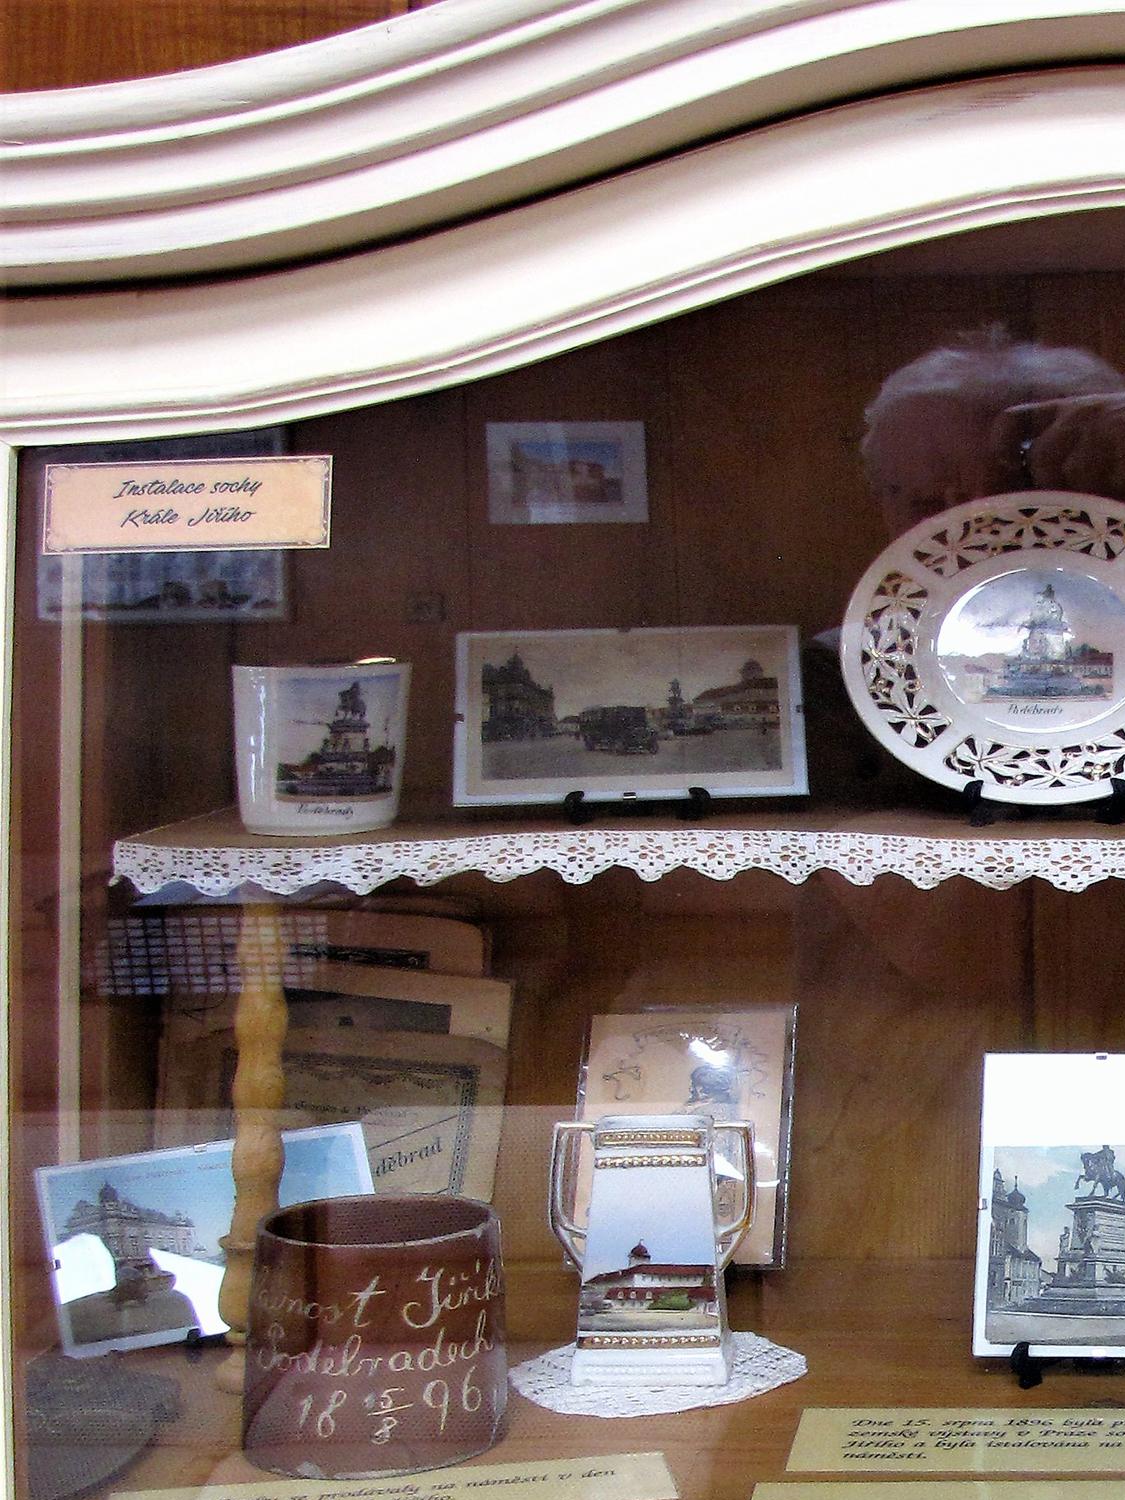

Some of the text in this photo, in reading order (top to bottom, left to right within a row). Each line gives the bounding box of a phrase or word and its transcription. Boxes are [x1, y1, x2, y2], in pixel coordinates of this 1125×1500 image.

[112, 477, 263, 499] Instalace sochy
[119, 507, 257, 528] Krále Jiřího
[374, 1136, 445, 1178] děbrad
[299, 1389, 347, 1439] 18
[422, 1365, 483, 1434] 96
[852, 1418, 894, 1428] Dne
[902, 1418, 931, 1427] 15.
[942, 1419, 995, 1430] srpna
[1007, 1418, 1054, 1427] 1896
[1062, 1417, 1104, 1429] byla
[1038, 1428, 1098, 1438] Praze
[933, 1438, 976, 1450] byla
[1099, 1440, 1123, 1448] na
[431, 1482, 457, 1492] na
[581, 1468, 617, 1479] den
